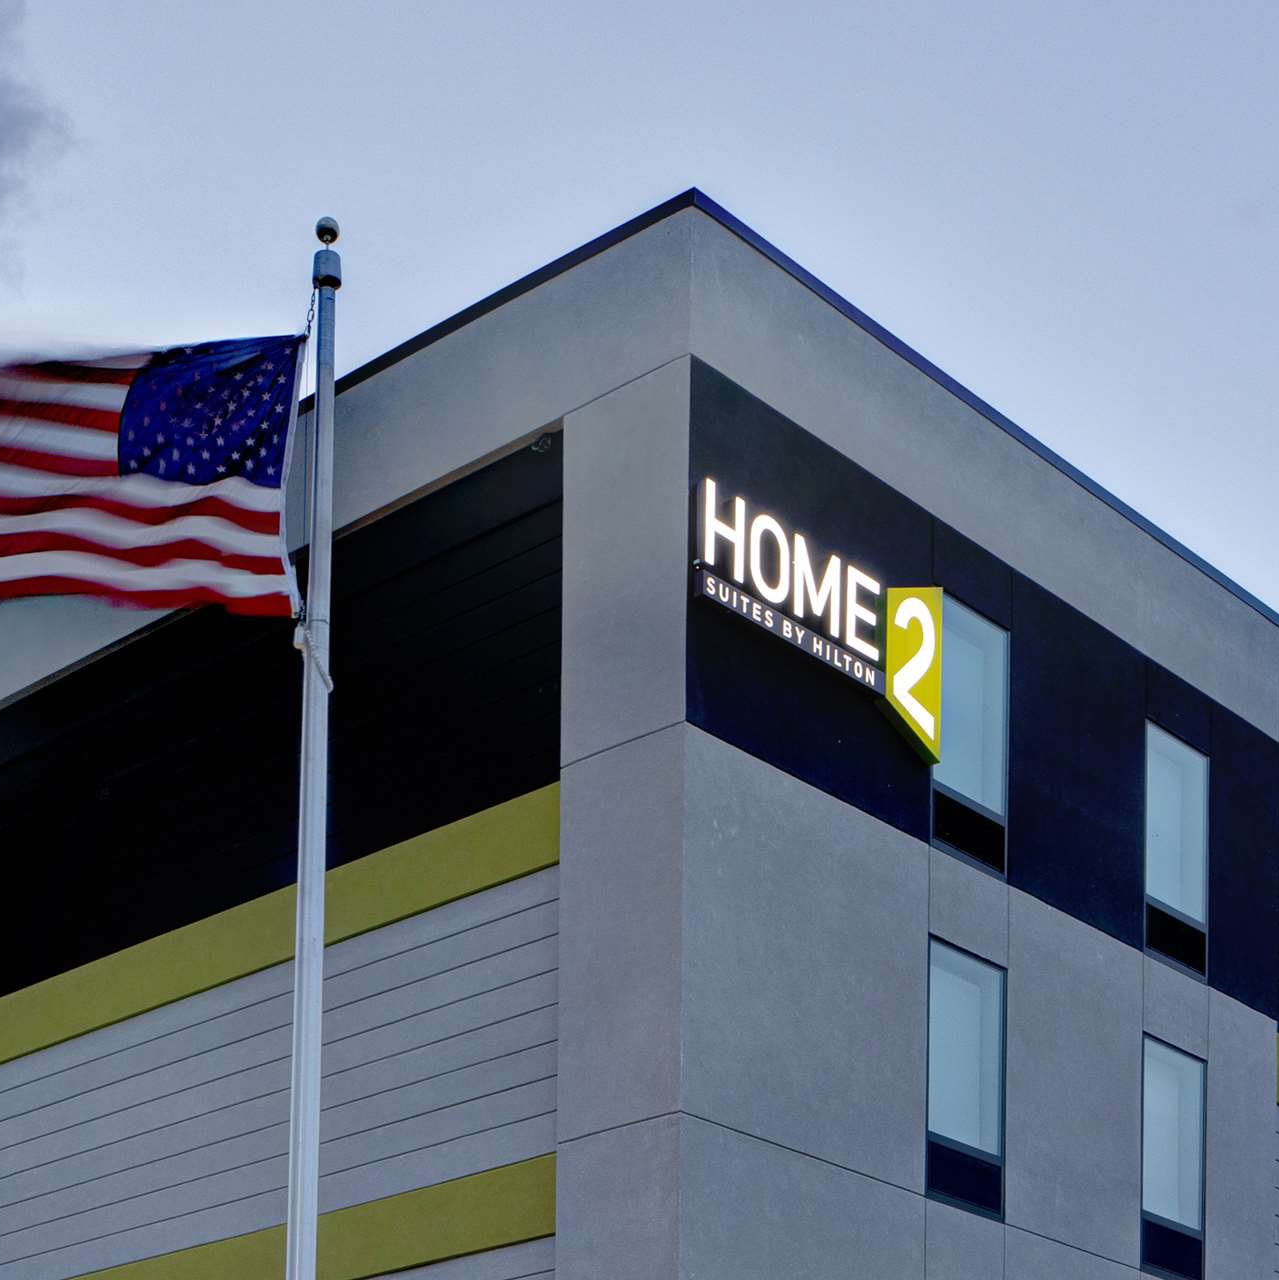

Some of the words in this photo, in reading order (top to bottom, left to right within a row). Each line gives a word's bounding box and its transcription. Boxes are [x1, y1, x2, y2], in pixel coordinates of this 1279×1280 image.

[704, 477, 880, 662] HOME
[705, 576, 773, 628] SUITES
[782, 621, 805, 645] BY
[813, 636, 875, 686] HILTON
